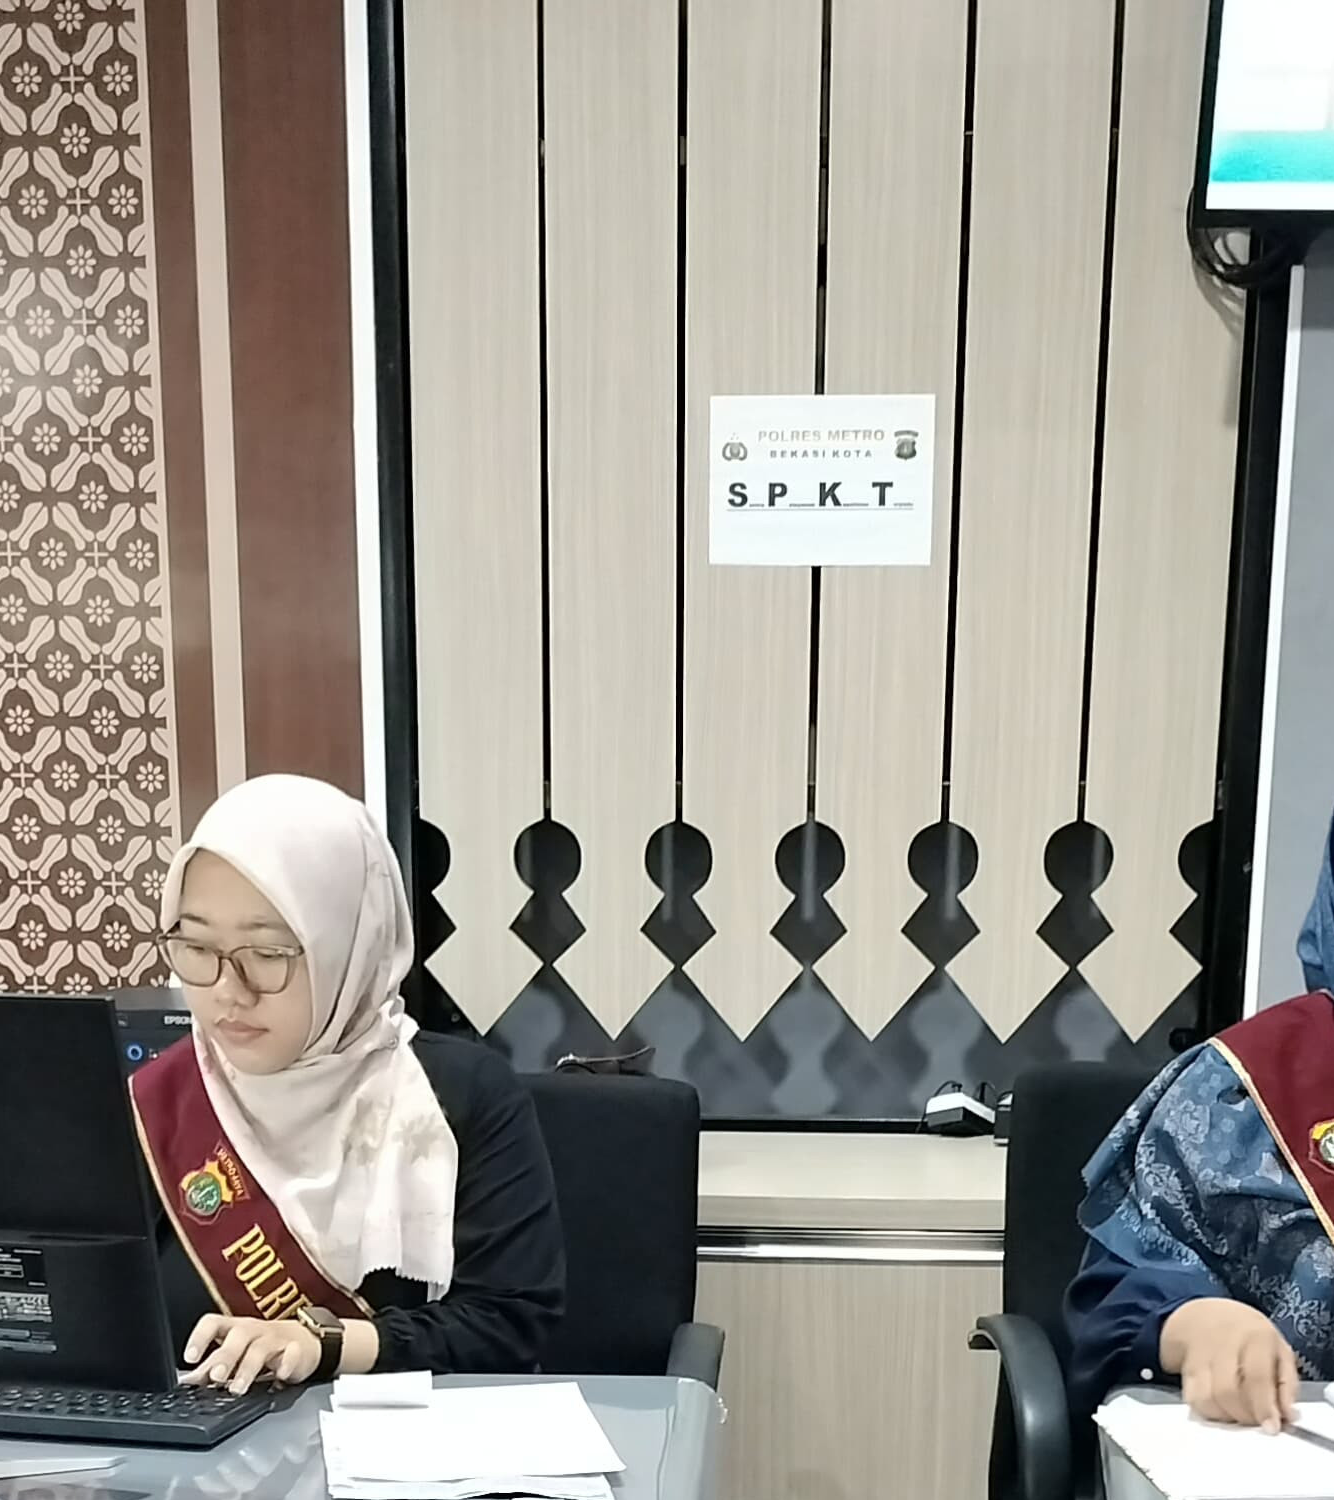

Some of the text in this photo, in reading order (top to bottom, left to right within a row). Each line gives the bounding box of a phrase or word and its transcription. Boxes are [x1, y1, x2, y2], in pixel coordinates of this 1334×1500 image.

[758, 430, 822, 442] POLRES
[827, 429, 886, 441] METRO
[770, 450, 873, 458] BEKASI KOTA
